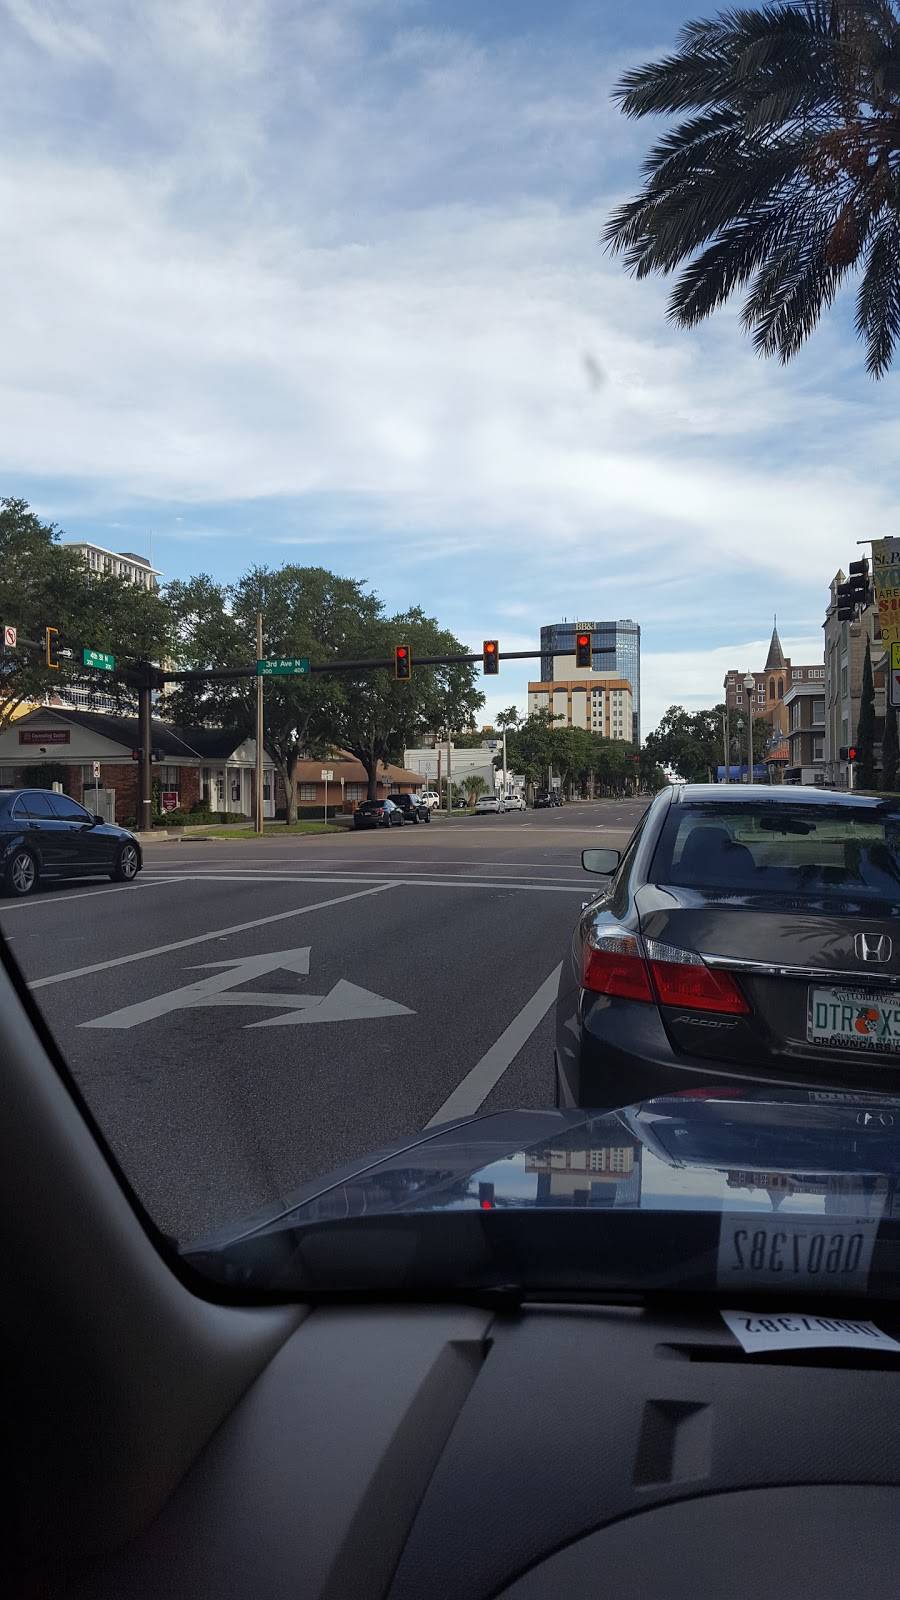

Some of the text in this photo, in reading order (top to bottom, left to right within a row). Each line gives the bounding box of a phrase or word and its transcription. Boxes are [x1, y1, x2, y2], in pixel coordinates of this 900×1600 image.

[265, 660, 278, 668] 3rd
[294, 659, 301, 667] N
[815, 1002, 854, 1034] DTR
